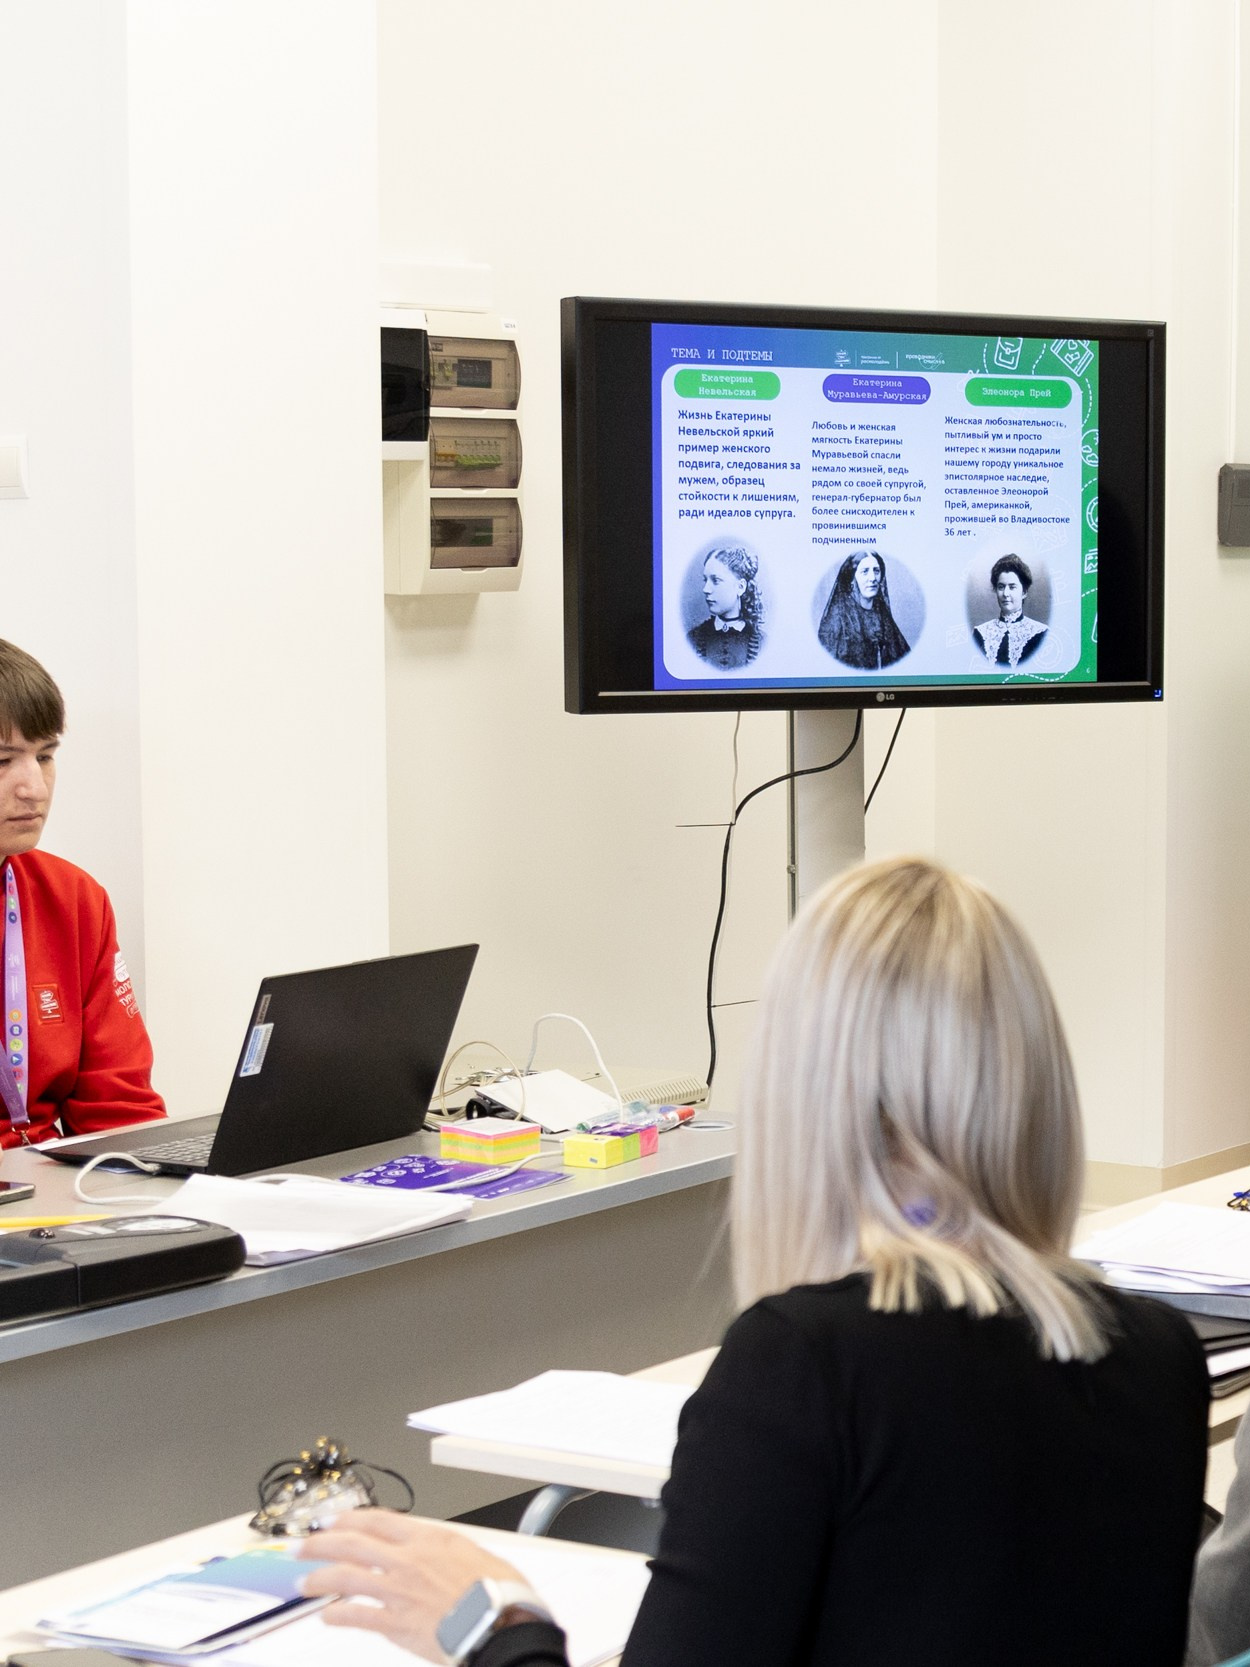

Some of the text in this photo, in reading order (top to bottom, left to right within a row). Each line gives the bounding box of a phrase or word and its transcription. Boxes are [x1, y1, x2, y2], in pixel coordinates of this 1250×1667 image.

[671, 347, 773, 360] ТЕМА И ПОДТЕМЫ
[702, 373, 753, 384] Екатерина
[852, 377, 902, 387] Екатерина
[698, 386, 756, 396] Невельская
[828, 389, 927, 401] Муравьева-Амурская
[982, 387, 1052, 397] Элеонора Прей
[678, 409, 772, 422] Жизнь Екатерины
[944, 415, 982, 425] Женская
[812, 420, 847, 430] Любовь
[858, 423, 896, 431] женская
[678, 425, 774, 438] Невельской яркий
[944, 430, 989, 440] пытливый
[991, 432, 1003, 440] ум
[1013, 433, 1042, 441] просто
[812, 435, 903, 446] мягкость Екатерины
[678, 444, 770, 454] пример женского
[812, 449, 900, 459] Муравьевой спасли
[944, 445, 980, 454] интерес
[1018, 446, 1060, 455] подарили
[678, 460, 800, 471] подвига, следования за
[848, 464, 886, 474] жизней,
[888, 465, 909, 474] ведь
[944, 459, 1064, 469] нашему городу уникальное
[678, 475, 765, 486] мужем, образец
[944, 473, 1050, 482] эпистолярное наследие,
[812, 479, 842, 488] рядом
[856, 478, 882, 487] своей
[884, 479, 926, 489] супругой,
[944, 486, 1048, 496] оставленное Элеонорой
[678, 491, 800, 503] стойкости к лишениям,
[812, 492, 922, 503] генерал-губернатор был
[944, 500, 1032, 510] Прей, американкой,
[678, 507, 796, 519] ради идеалов супруга.
[812, 506, 915, 517] более снисходителен к
[944, 514, 996, 523] прожившей
[1011, 515, 1070, 524] Владивостоке
[812, 521, 886, 531] провинившимся
[944, 528, 955, 536] 36
[812, 535, 876, 545] подчиненным
